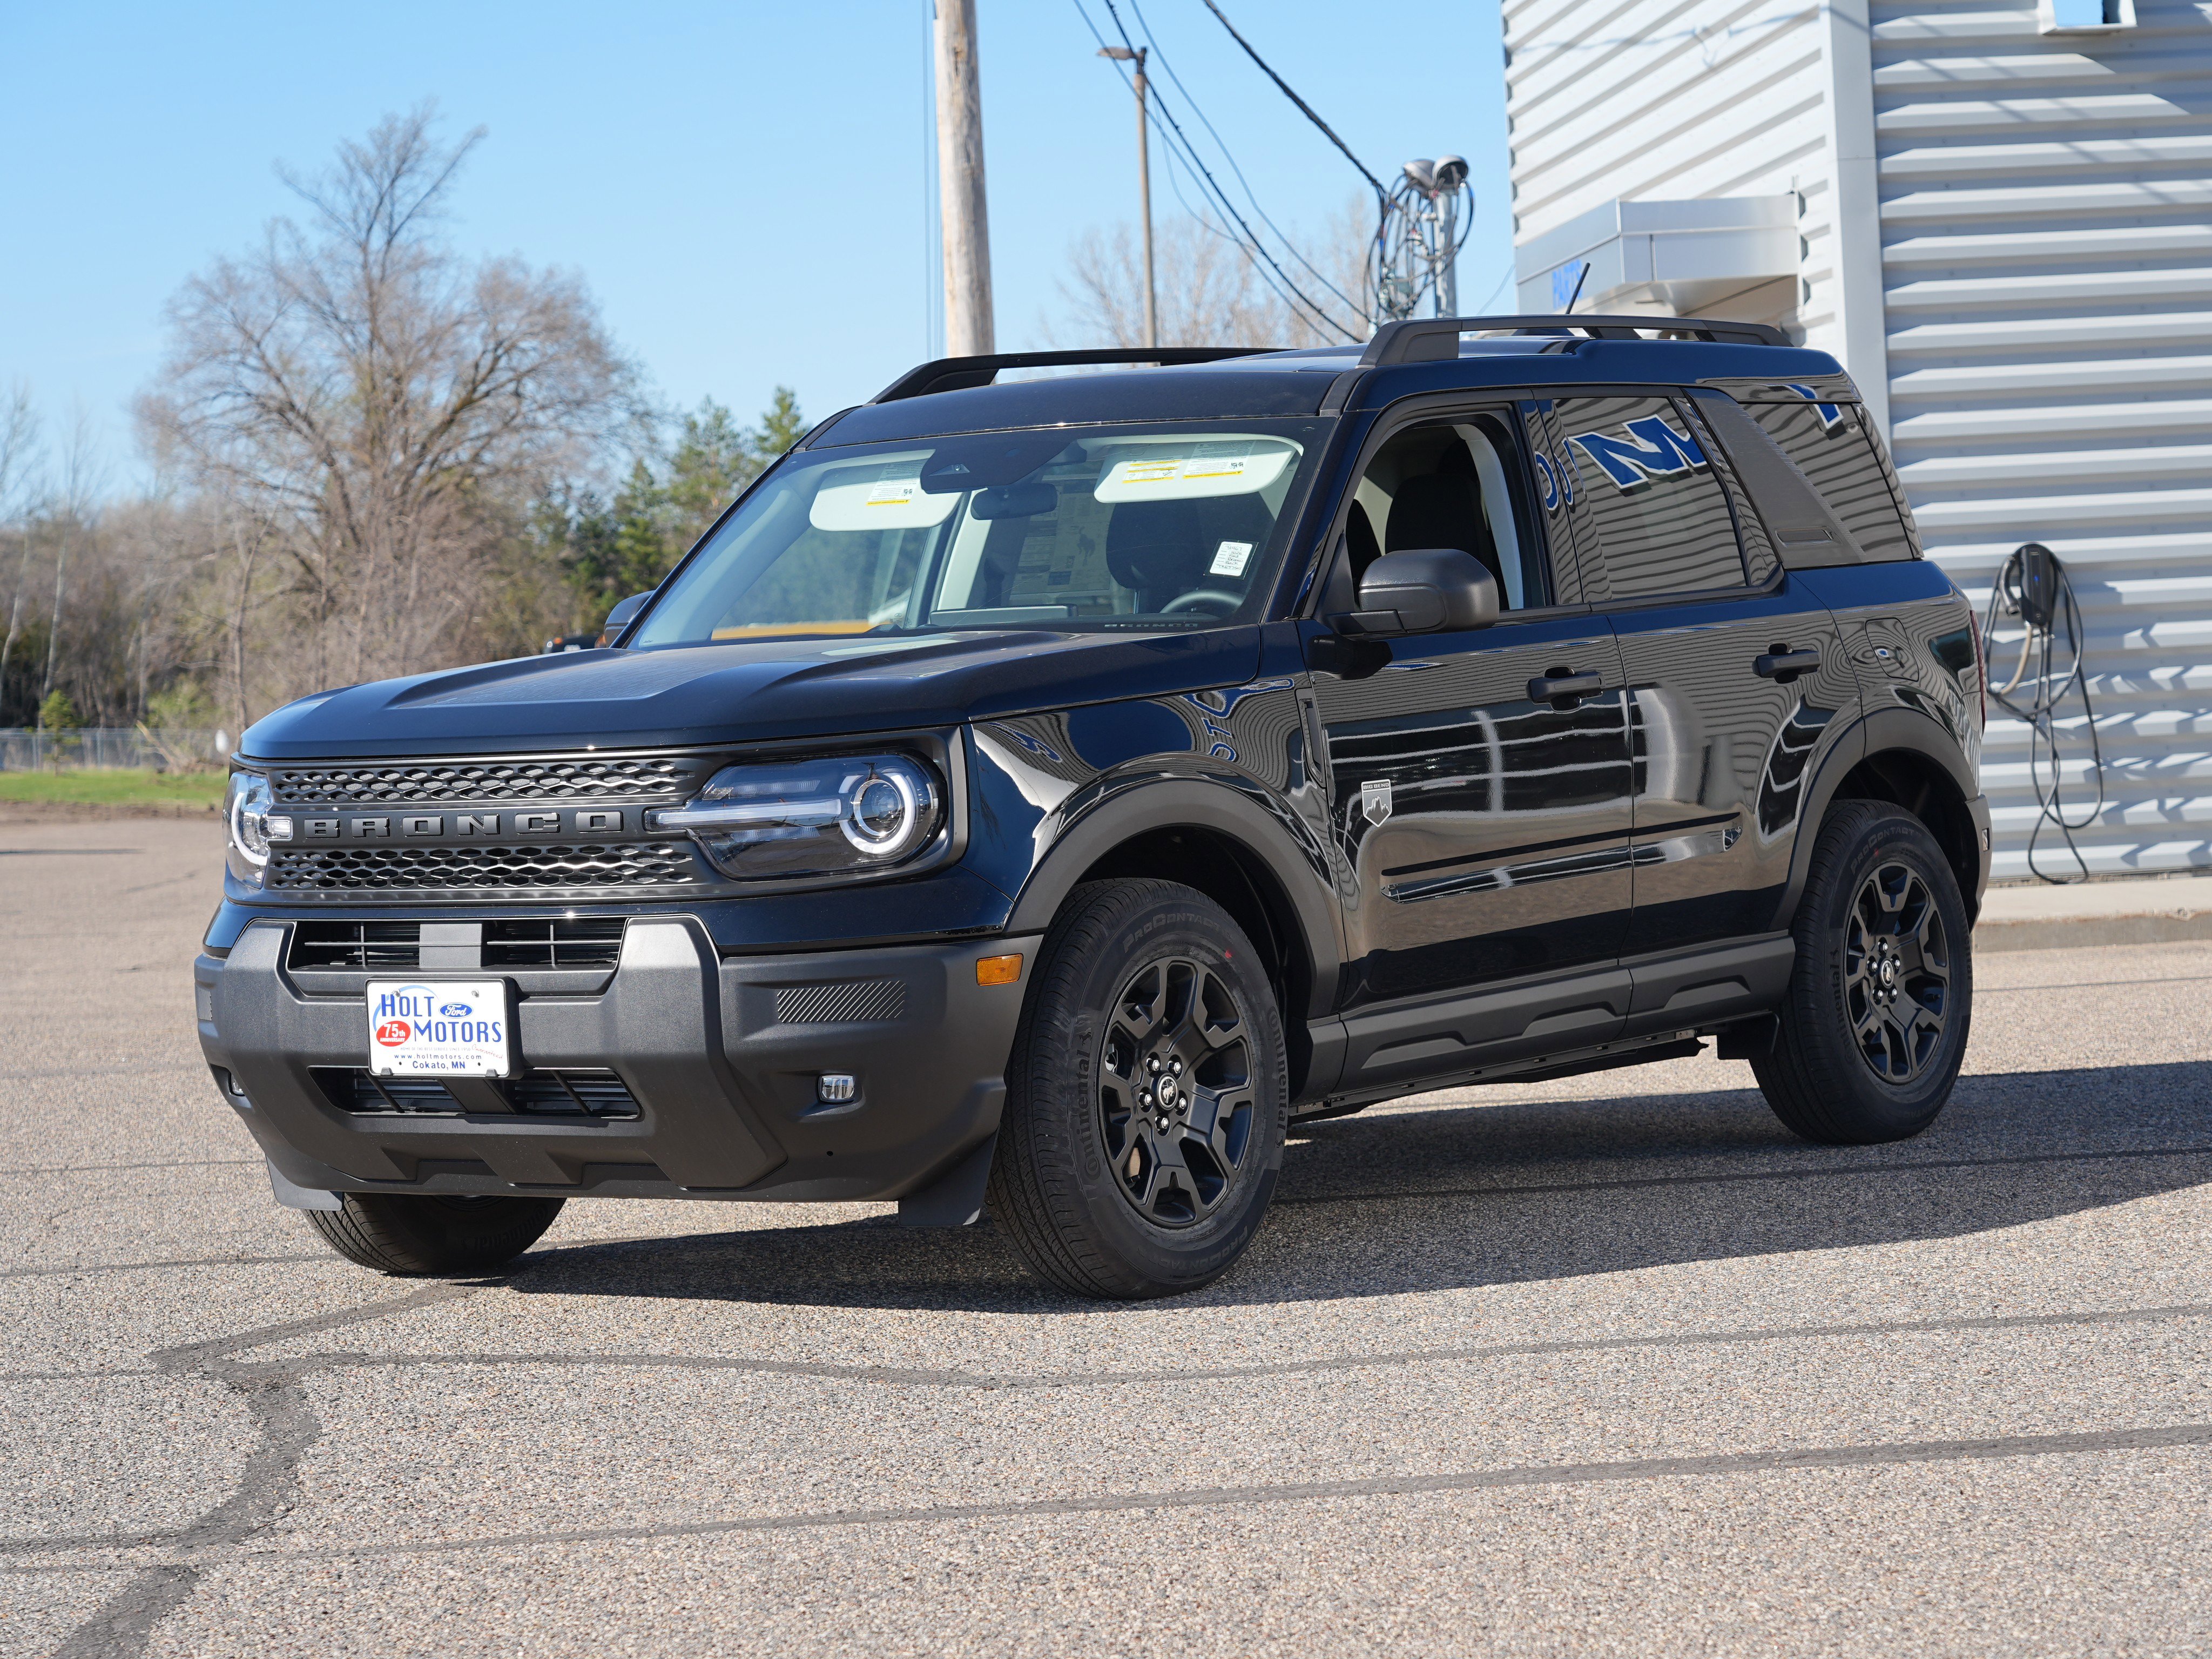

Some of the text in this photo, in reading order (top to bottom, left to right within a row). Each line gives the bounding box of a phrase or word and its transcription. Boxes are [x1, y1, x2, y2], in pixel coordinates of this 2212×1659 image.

[304, 811, 624, 839] BRONCO
[381, 994, 434, 1017] HOLT
[445, 1004, 467, 1017] Ford
[383, 1023, 406, 1038] 75th
[414, 1019, 502, 1042] MOTORS
[471, 1044, 503, 1059] Guaranteed
[413, 1061, 449, 1070] Cokato,
[1076, 1049, 1101, 1180] Continental
